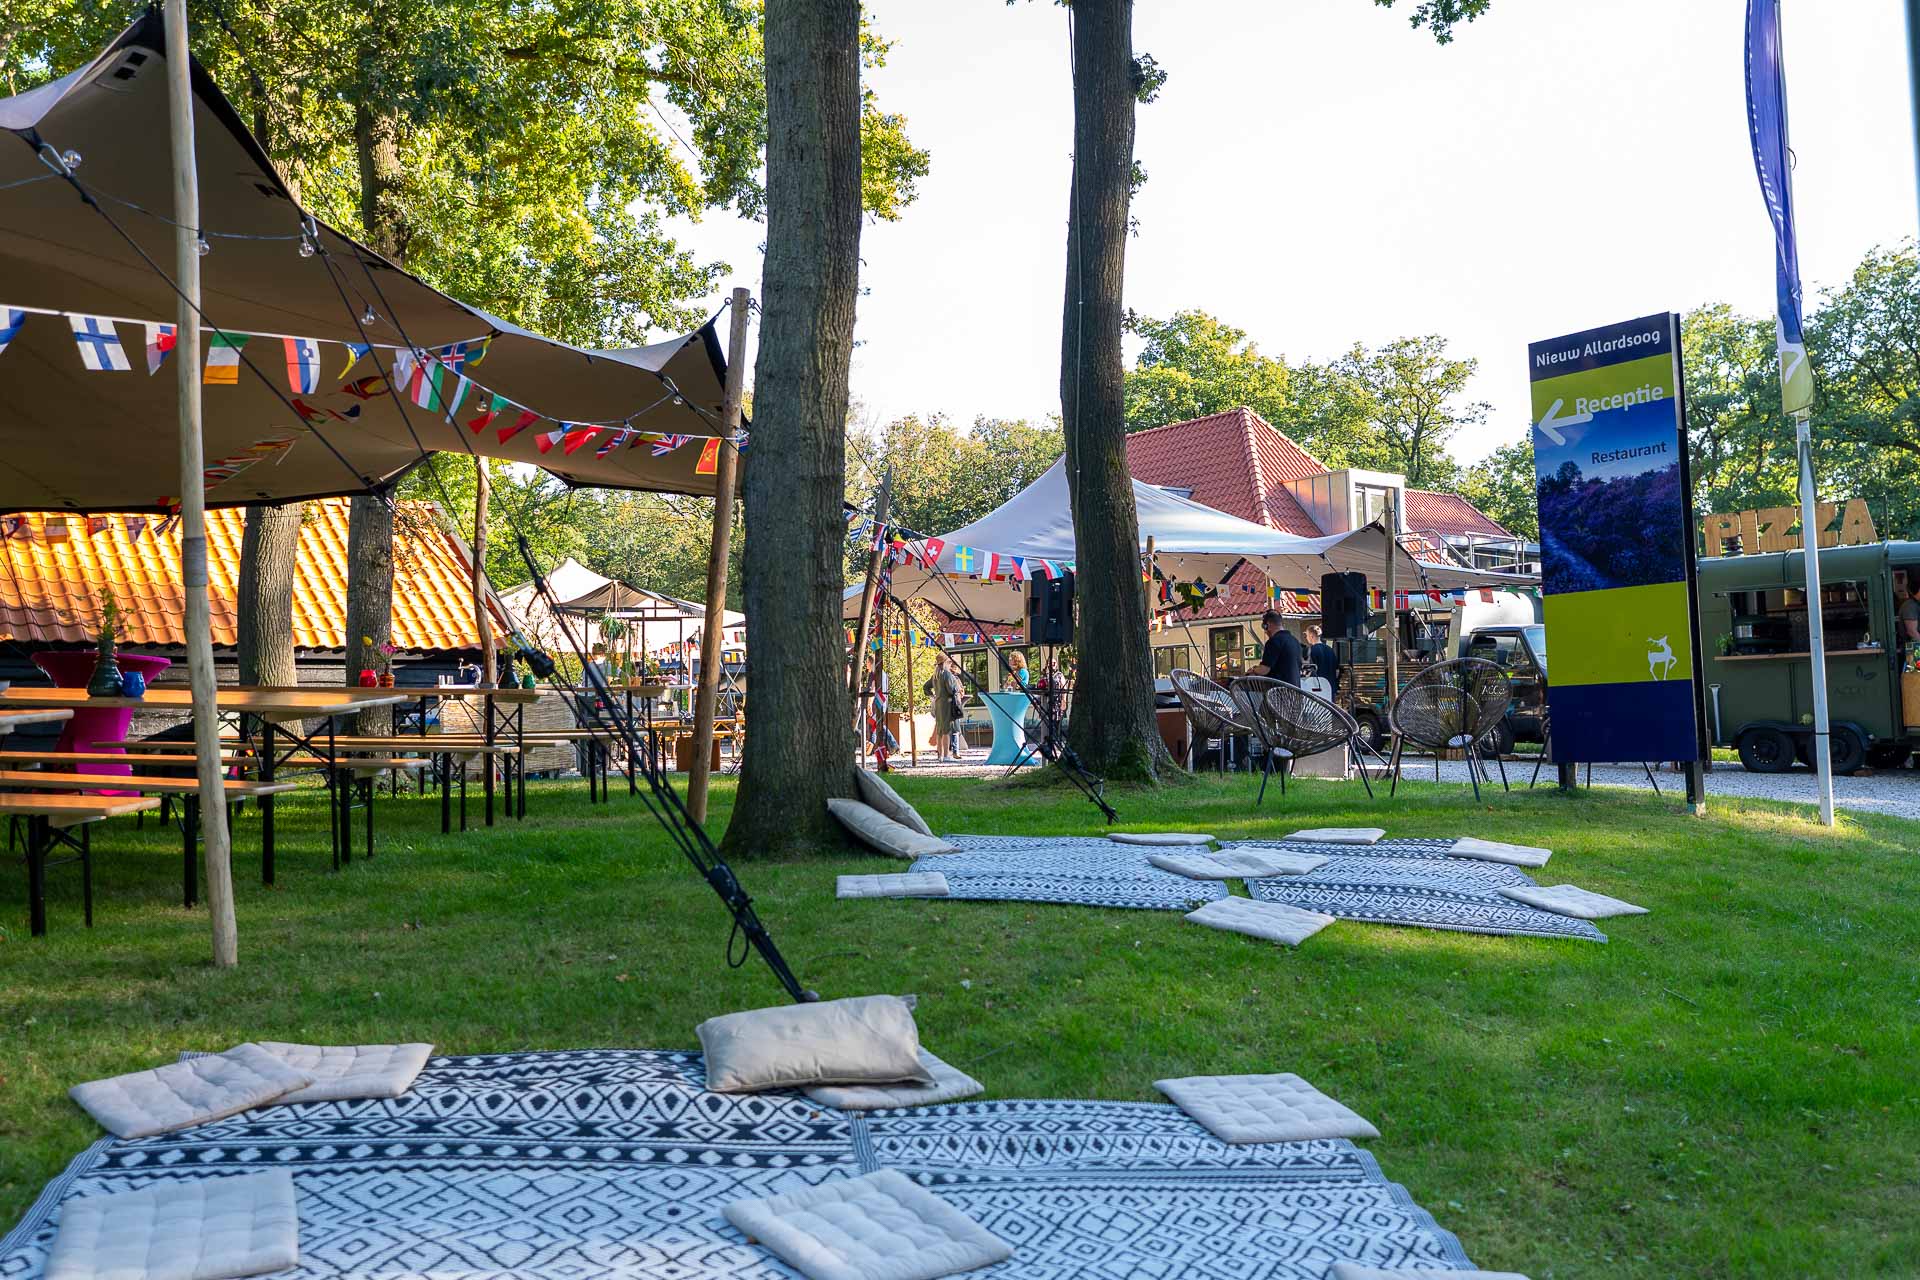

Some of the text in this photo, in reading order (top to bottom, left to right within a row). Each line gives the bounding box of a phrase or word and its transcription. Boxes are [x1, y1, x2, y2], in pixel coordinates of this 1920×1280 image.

[1536, 330, 1661, 367] Nieuw Allardsoog
[1575, 383, 1664, 416] Receptie
[1591, 441, 1667, 464] Restaurant
[1704, 498, 1877, 557] PIZZA
